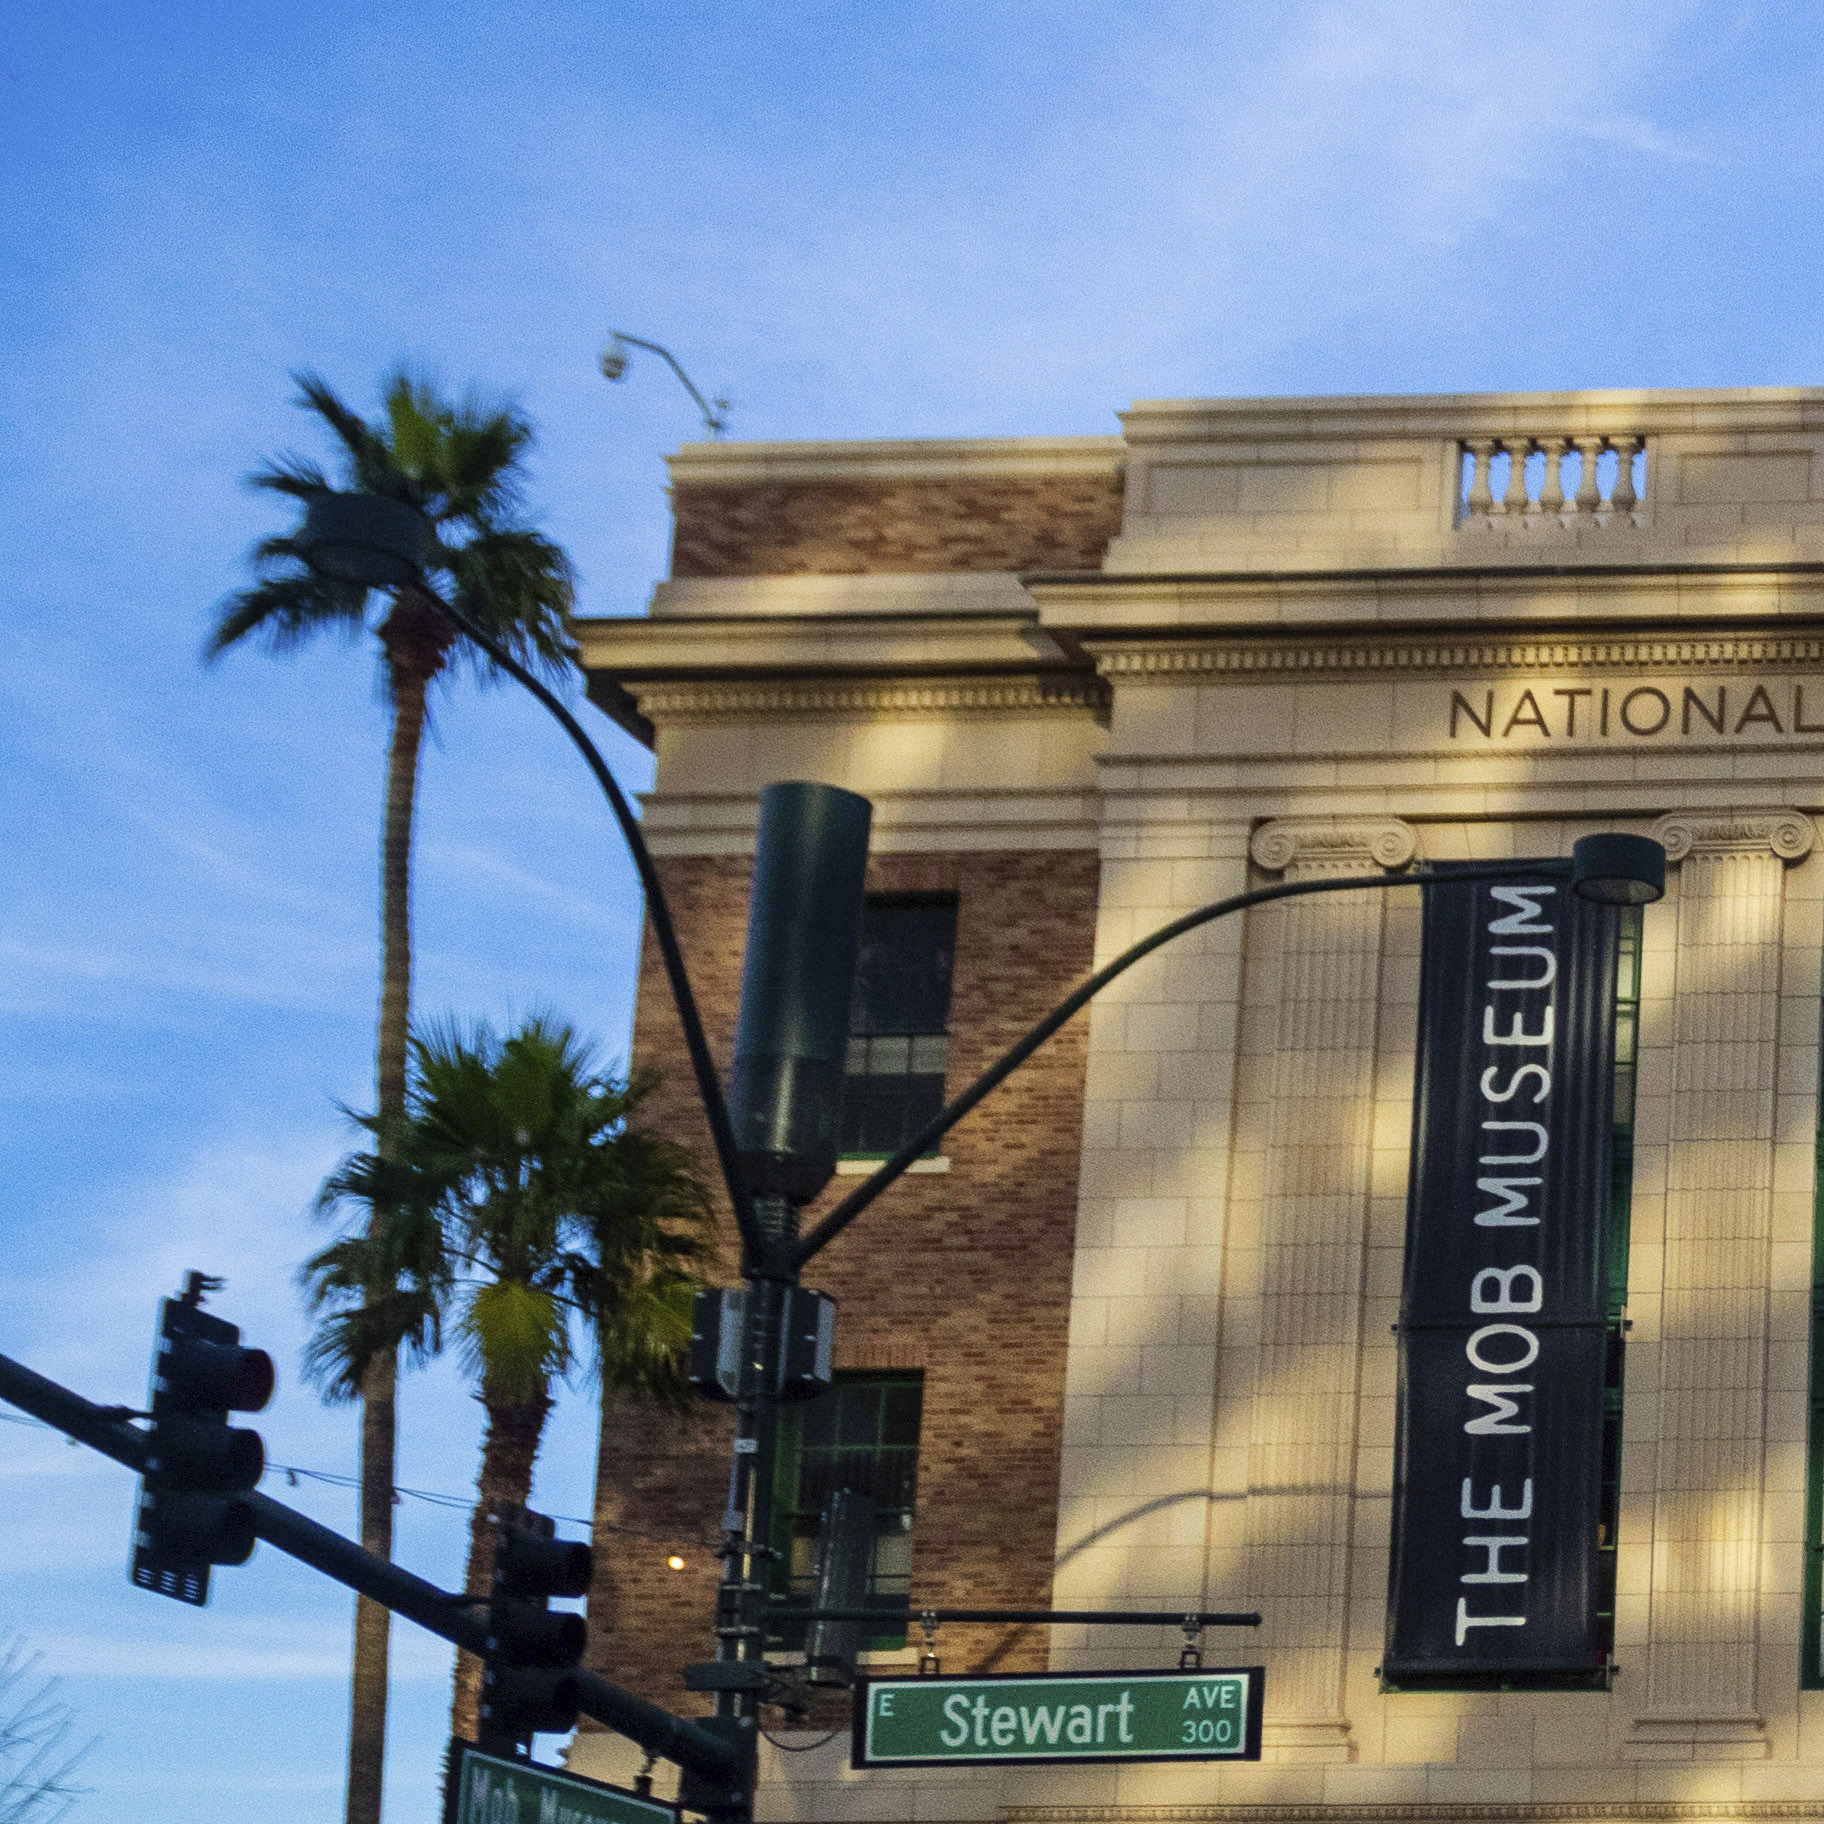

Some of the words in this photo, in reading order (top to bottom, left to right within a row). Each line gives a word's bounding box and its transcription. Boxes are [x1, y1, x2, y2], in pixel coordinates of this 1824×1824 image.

[1473, 885, 1558, 1227] MUSEUM
[1463, 1263, 1544, 1435] MOB
[1454, 1477, 1534, 1647] THE
[878, 1693, 895, 1717] E
[938, 1690, 1134, 1748] Stewart
[1182, 1685, 1236, 1710] AVE
[1181, 1719, 1232, 1744] 300
